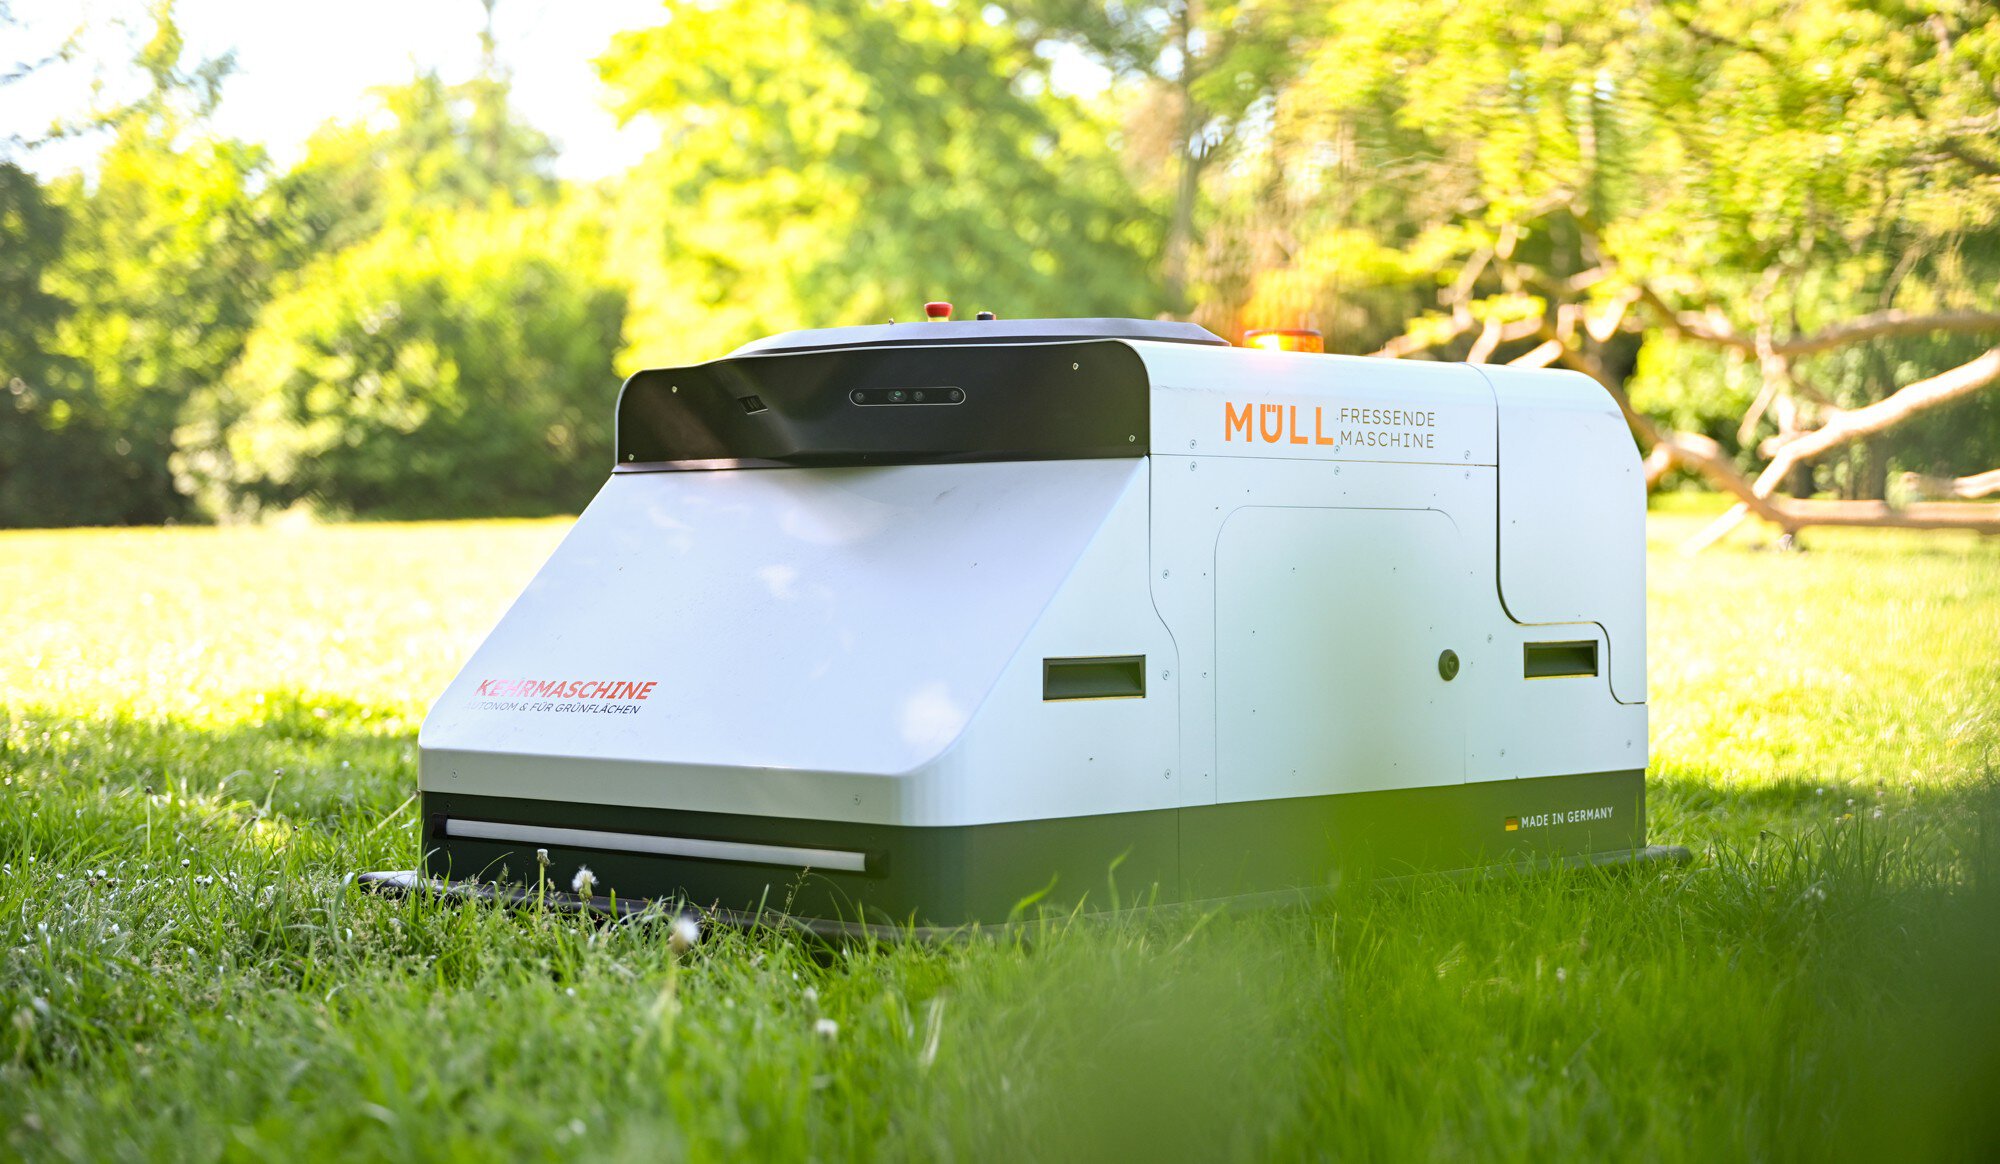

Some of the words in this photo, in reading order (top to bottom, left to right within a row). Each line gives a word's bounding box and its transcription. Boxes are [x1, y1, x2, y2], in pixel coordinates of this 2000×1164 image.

[1225, 402, 1334, 445] MÜLL
[1340, 408, 1435, 427] FRESSENDE
[1340, 430, 1434, 448] MASCHINE
[474, 679, 658, 700] KEHRMASCHINE
[519, 702, 527, 711] &
[529, 702, 554, 712] FÜR
[555, 702, 641, 715] GRÜNFLÄCHEN
[1521, 814, 1549, 828] MADE
[1552, 812, 1564, 825] IN
[1567, 807, 1613, 823] GERMANY
